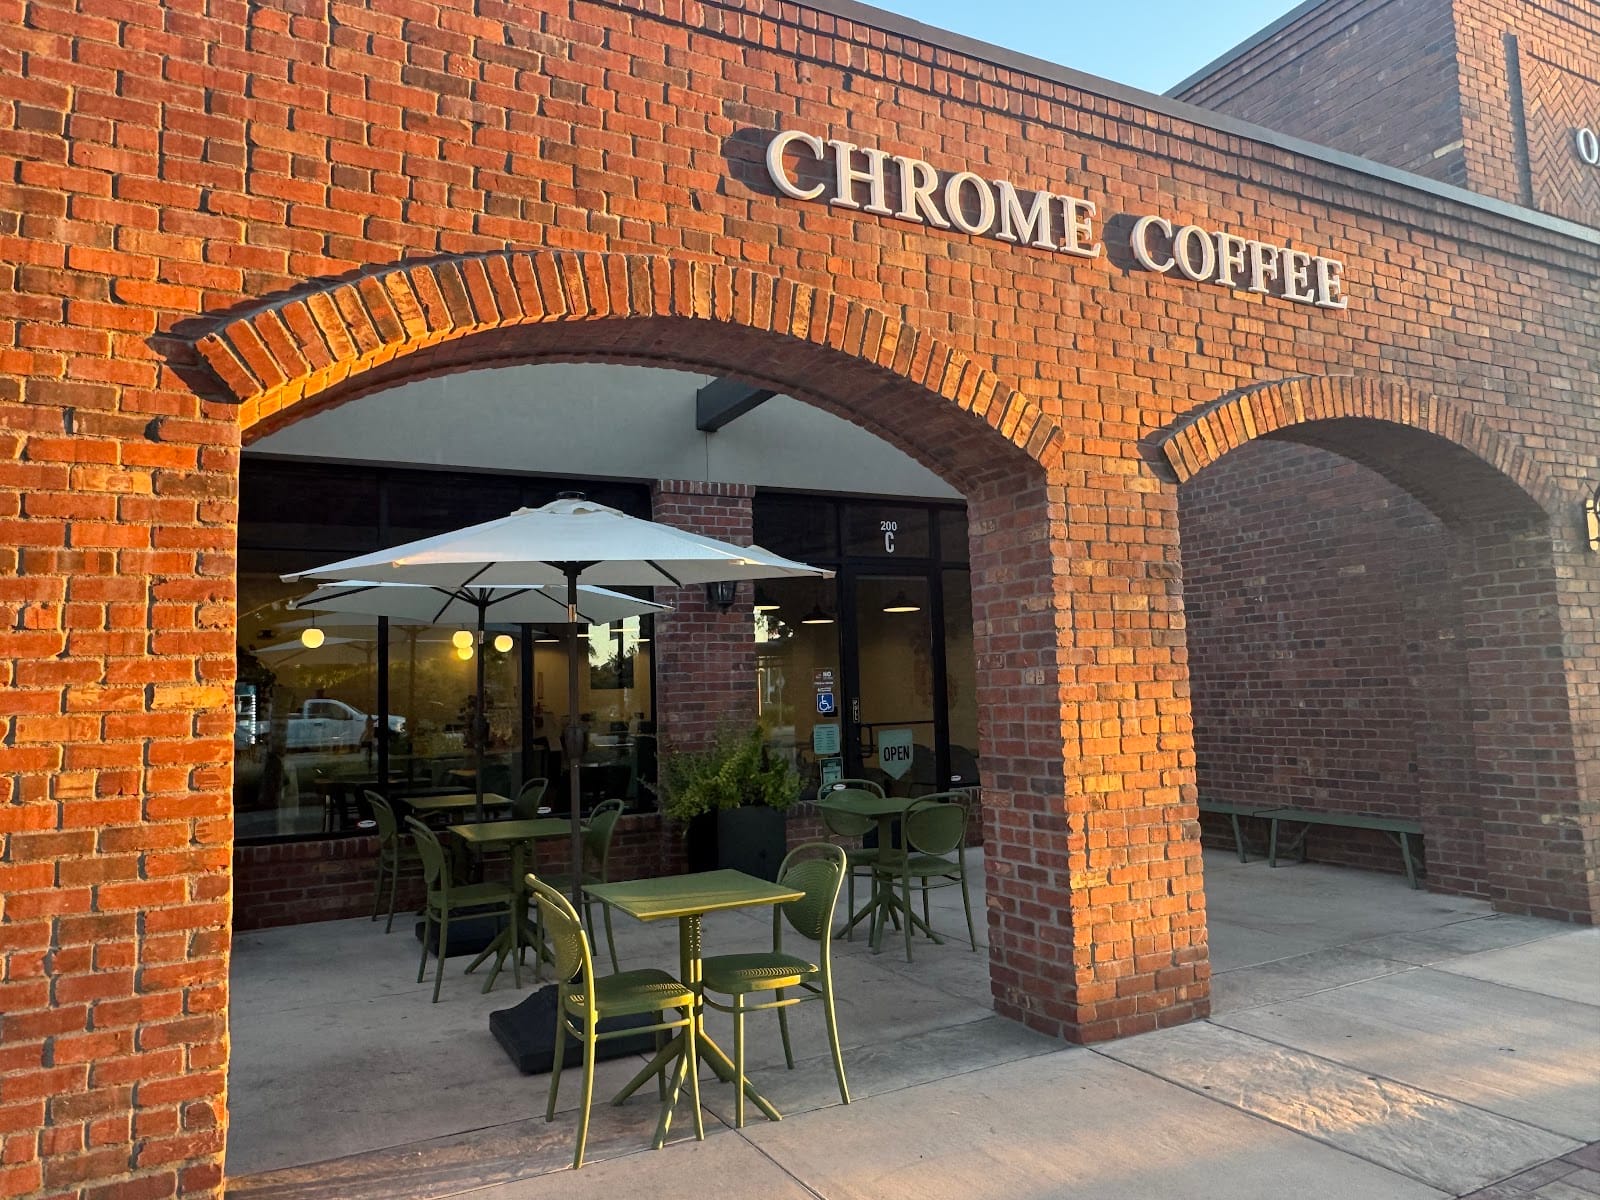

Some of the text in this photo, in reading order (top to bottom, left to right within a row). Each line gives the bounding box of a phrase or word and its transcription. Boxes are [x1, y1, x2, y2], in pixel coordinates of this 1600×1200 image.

[766, 130, 1348, 310] CHROME COFFEE
[880, 520, 897, 531] 200
[885, 531, 895, 553] C
[883, 745, 910, 762] OPEN
